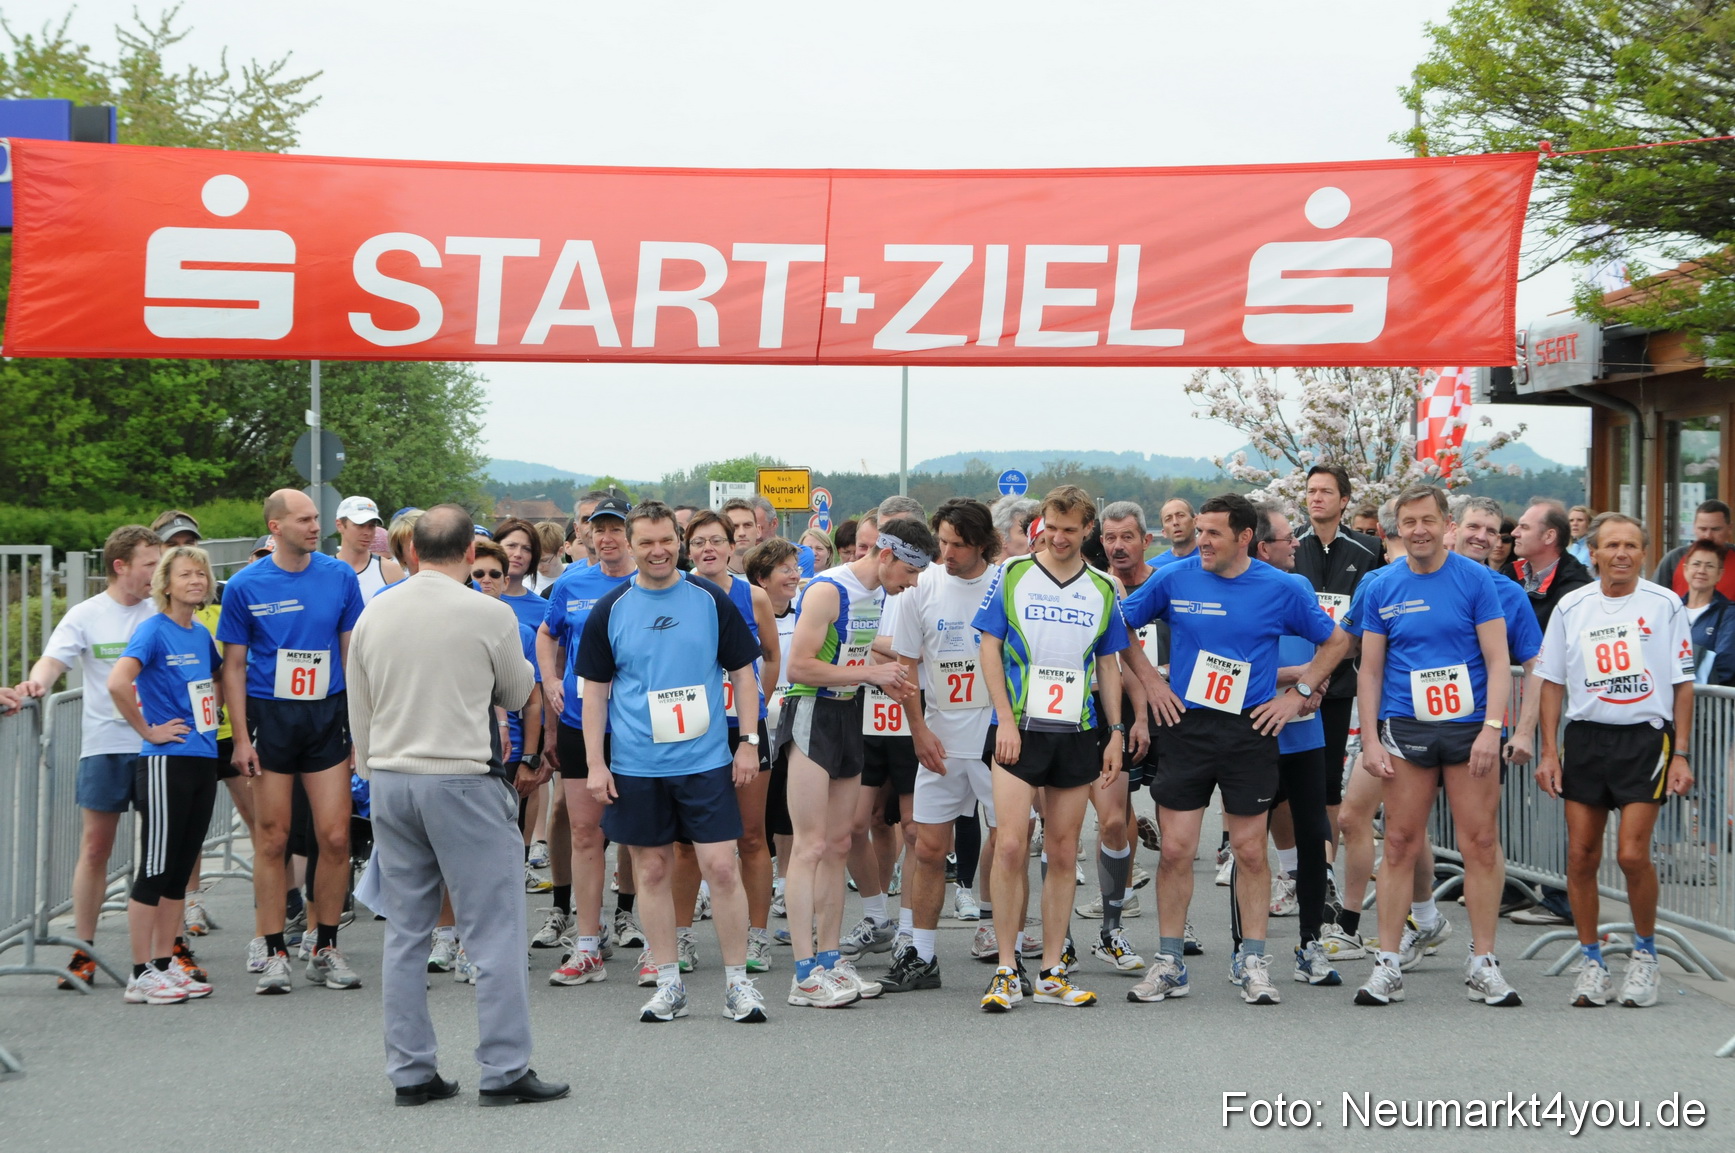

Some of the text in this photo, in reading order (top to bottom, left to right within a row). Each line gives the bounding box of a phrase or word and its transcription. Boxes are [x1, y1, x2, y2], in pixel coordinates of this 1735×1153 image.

[1535, 332, 1579, 367] SEAT
[763, 484, 805, 494] Neumarkt
[851, 619, 879, 629] BOCK
[1025, 604, 1095, 628] BOCK
[1590, 628, 1615, 638] MEYER
[940, 661, 963, 669] MEYER
[1206, 656, 1232, 668] MEYER
[1595, 640, 1631, 674] 86
[291, 667, 316, 696] 61
[1038, 669, 1065, 677] MEYER
[1420, 669, 1447, 679] MEYER
[657, 689, 684, 700] MEYER
[947, 673, 975, 703] 27
[1047, 684, 1064, 715] 2
[1204, 671, 1234, 704] 16
[1426, 683, 1461, 716] 66
[672, 703, 686, 734] 1
[874, 703, 902, 732] 59
